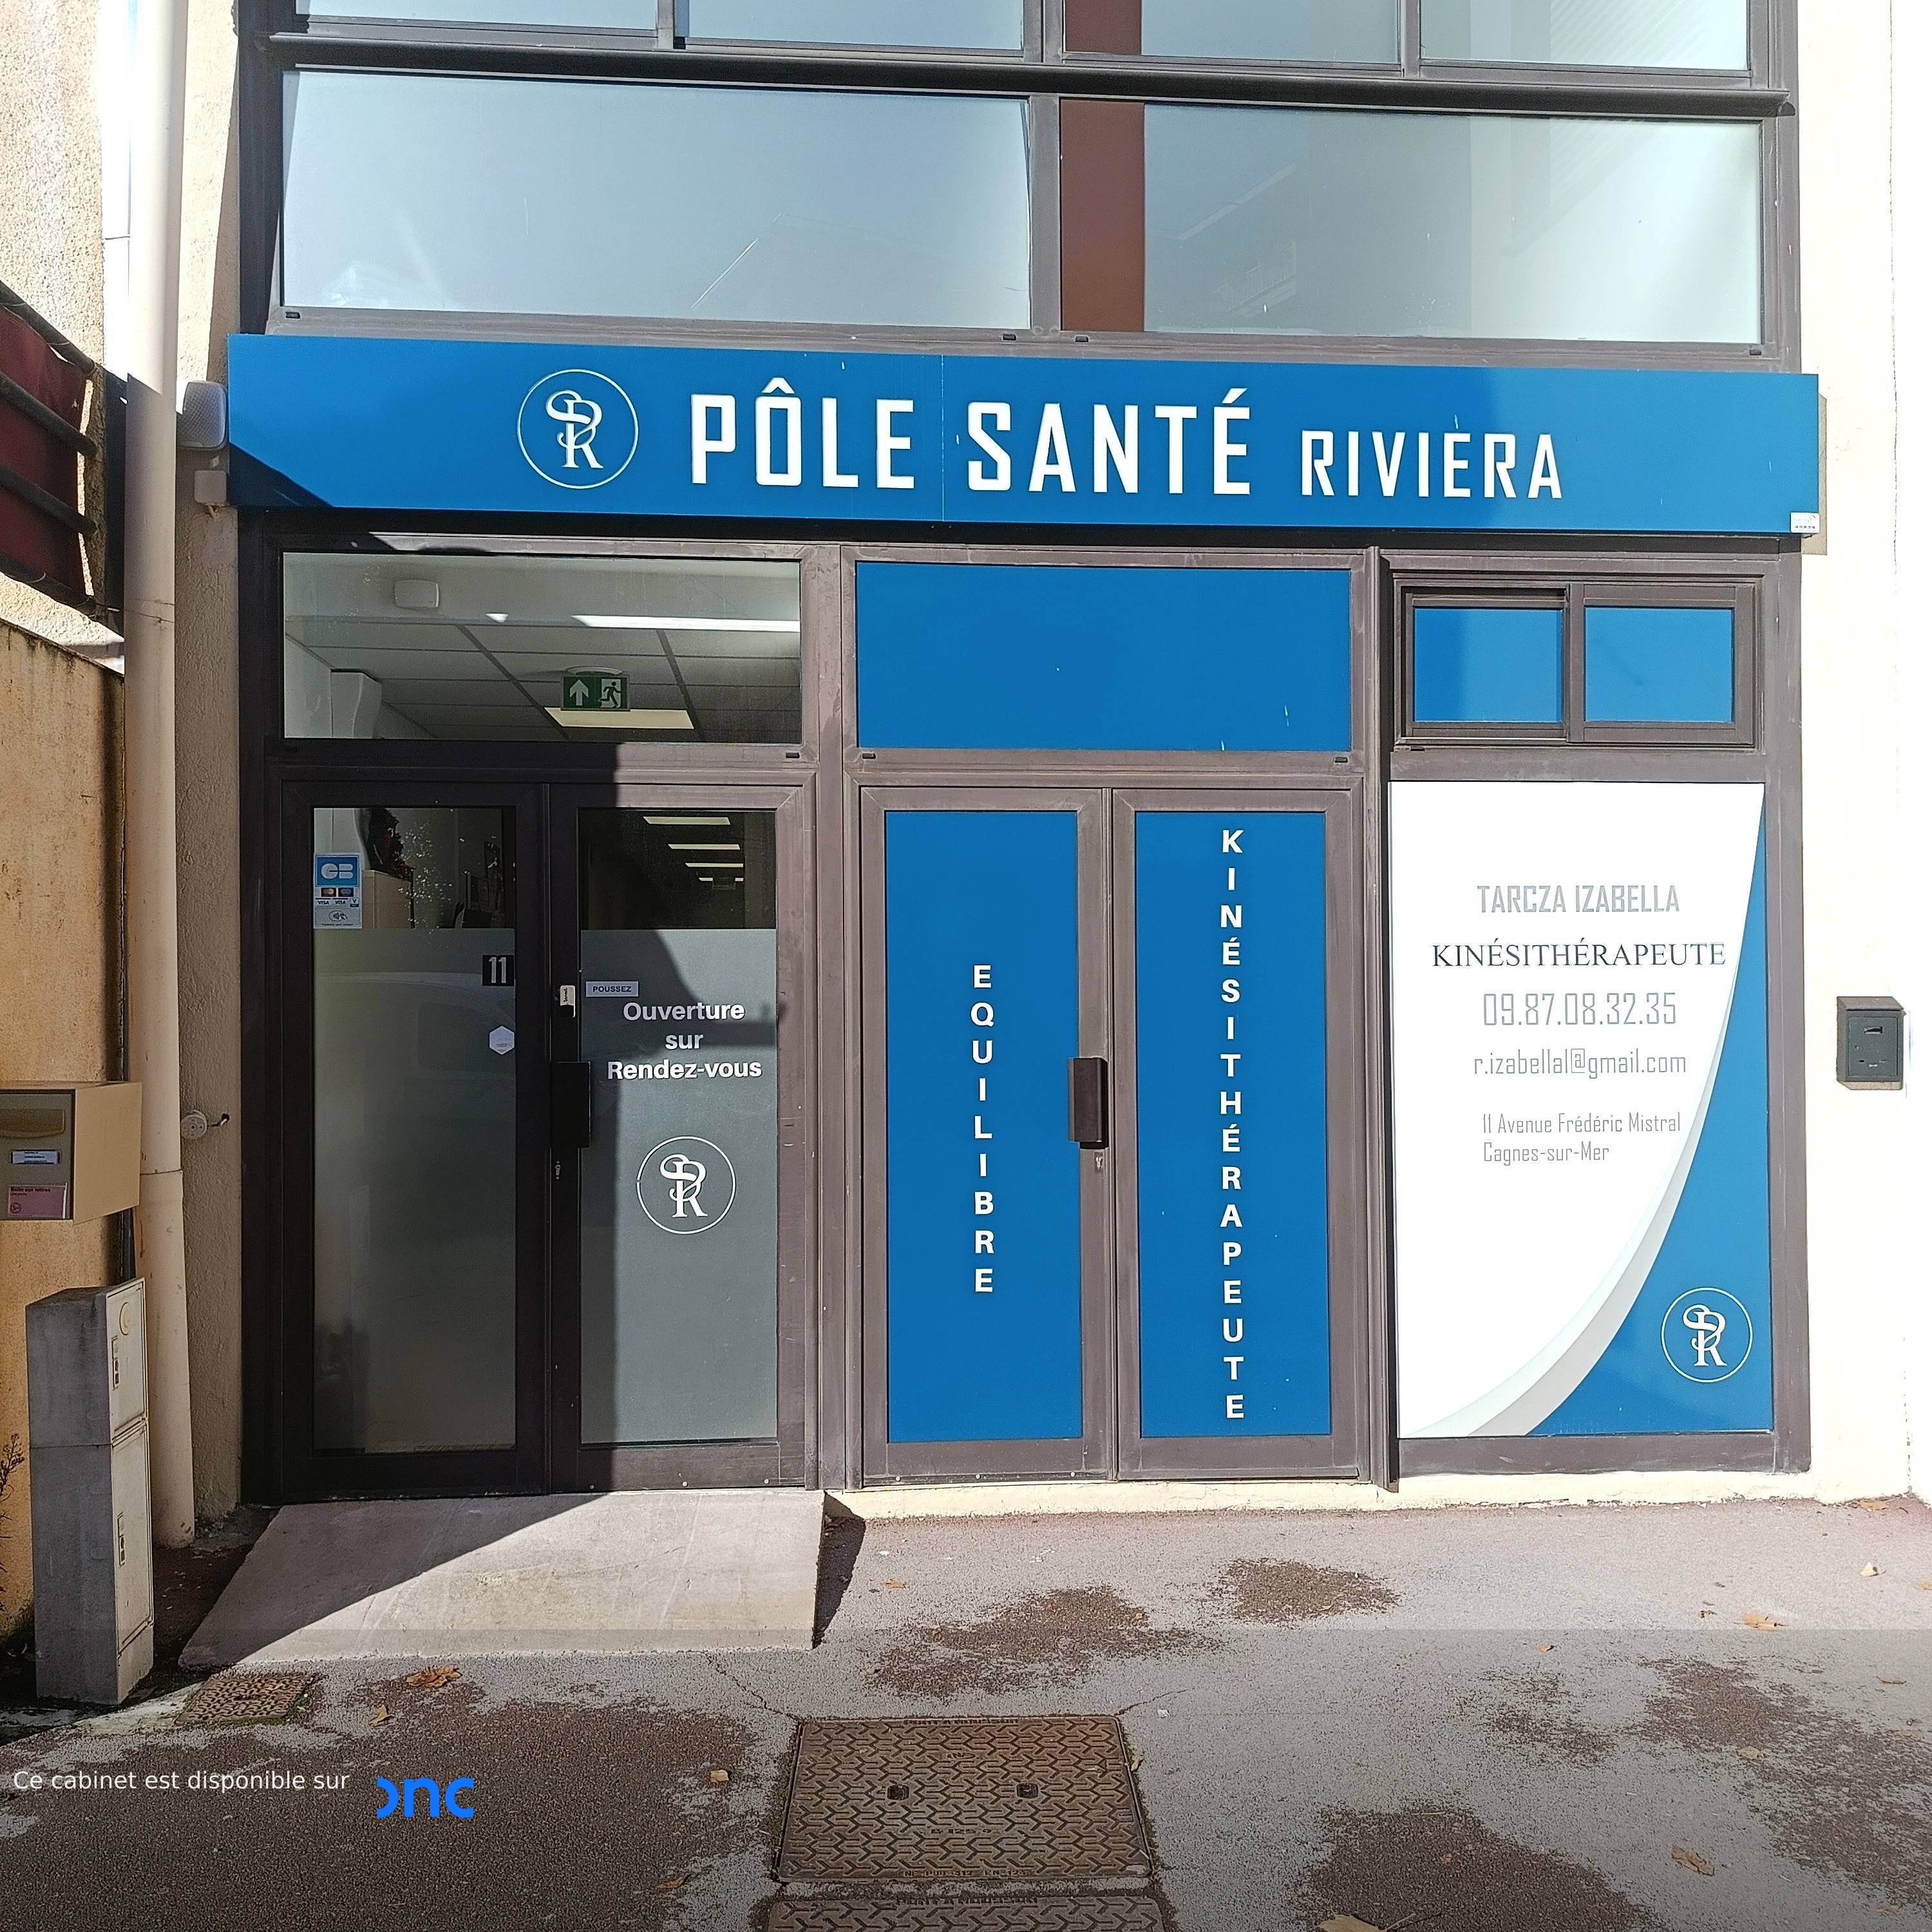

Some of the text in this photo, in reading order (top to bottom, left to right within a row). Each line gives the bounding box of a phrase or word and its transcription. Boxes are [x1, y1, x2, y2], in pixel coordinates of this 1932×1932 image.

[691, 378, 1562, 498] PÔLE SANTÉ RIVIERA
[1477, 885, 1680, 913] TARCZA IZABELLA
[1432, 938, 1726, 967] KINÉSITHÉRAPEUTE
[489, 956, 507, 983] 11
[623, 1002, 746, 1021] Ouverture
[1483, 992, 1676, 1026] 09.87.08.32.35
[665, 1033, 703, 1050] sur
[607, 1059, 762, 1079] Rendez-vous
[971, 964, 995, 1293] EQUILIBRE
[1220, 829, 1245, 1419] KINÉSITHÉRAPEUTE
[1498, 1113, 1552, 1133] Avenue
[1558, 1112, 1622, 1133] Frédéric
[1629, 1112, 1680, 1132] Mistral
[1484, 1141, 1609, 1166] Cagnes-sur-Mer
